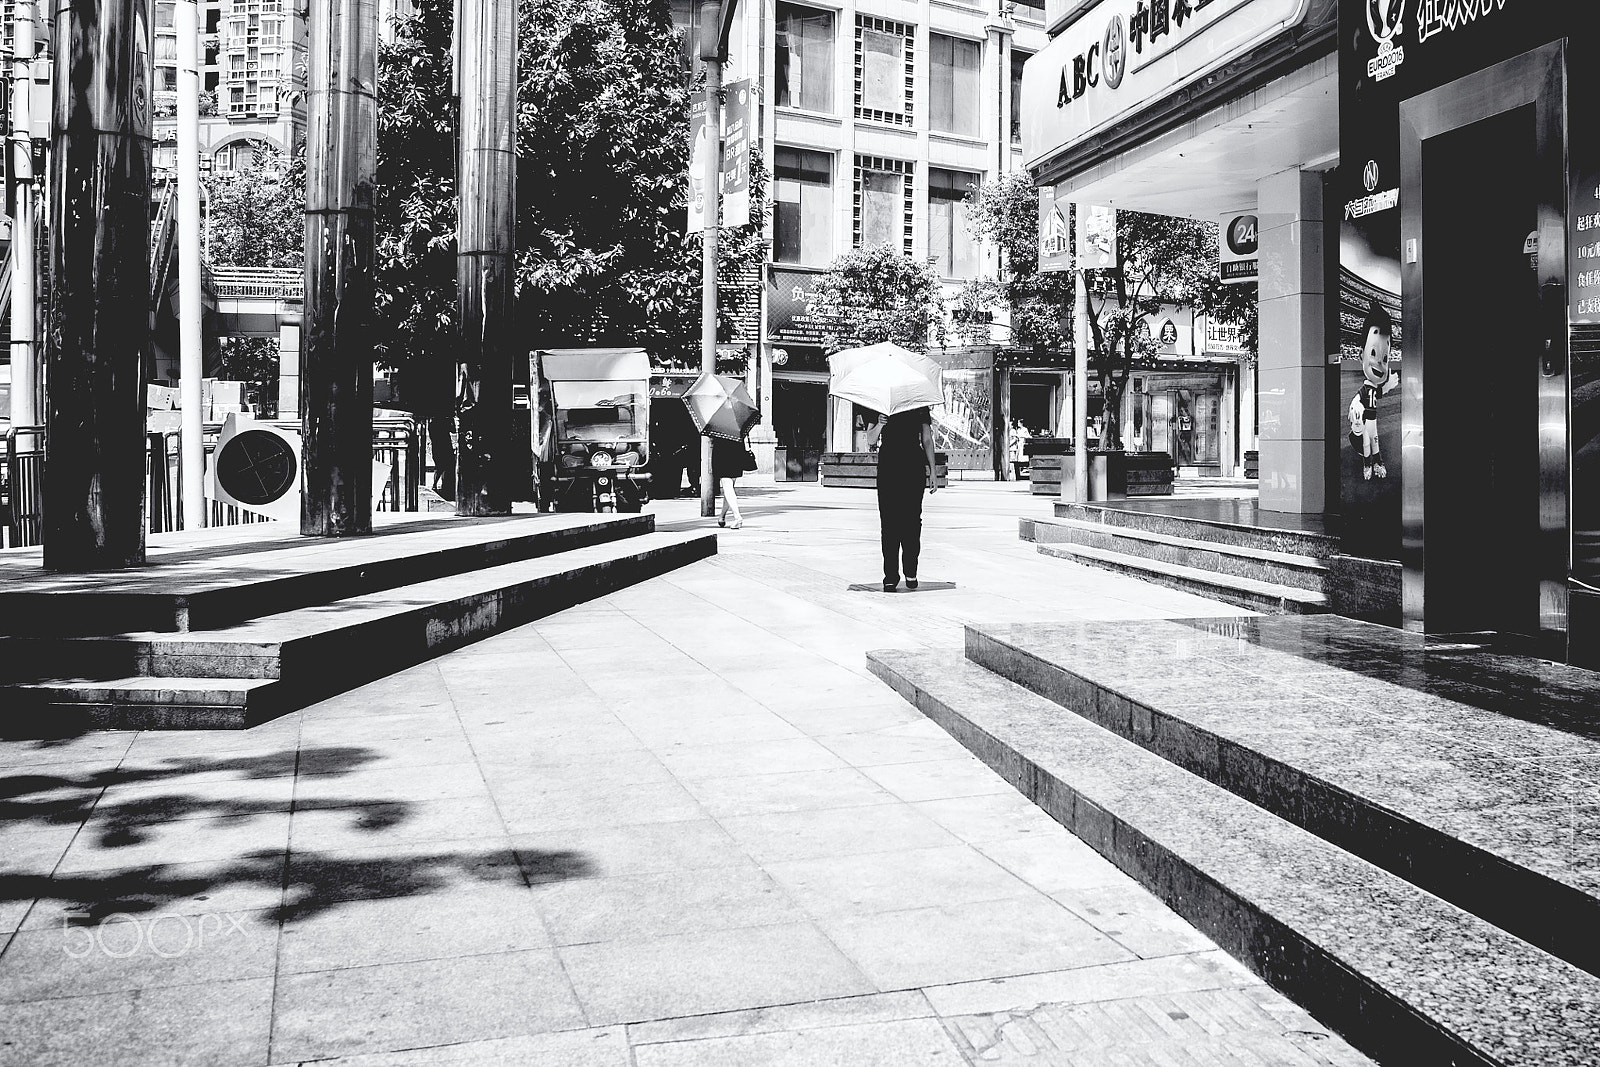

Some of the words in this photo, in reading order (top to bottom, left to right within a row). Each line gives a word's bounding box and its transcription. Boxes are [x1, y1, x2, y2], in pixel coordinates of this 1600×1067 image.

[1057, 41, 1100, 108] ABC
[1377, 68, 1394, 79] FRANCE
[1368, 389, 1377, 408] 16
